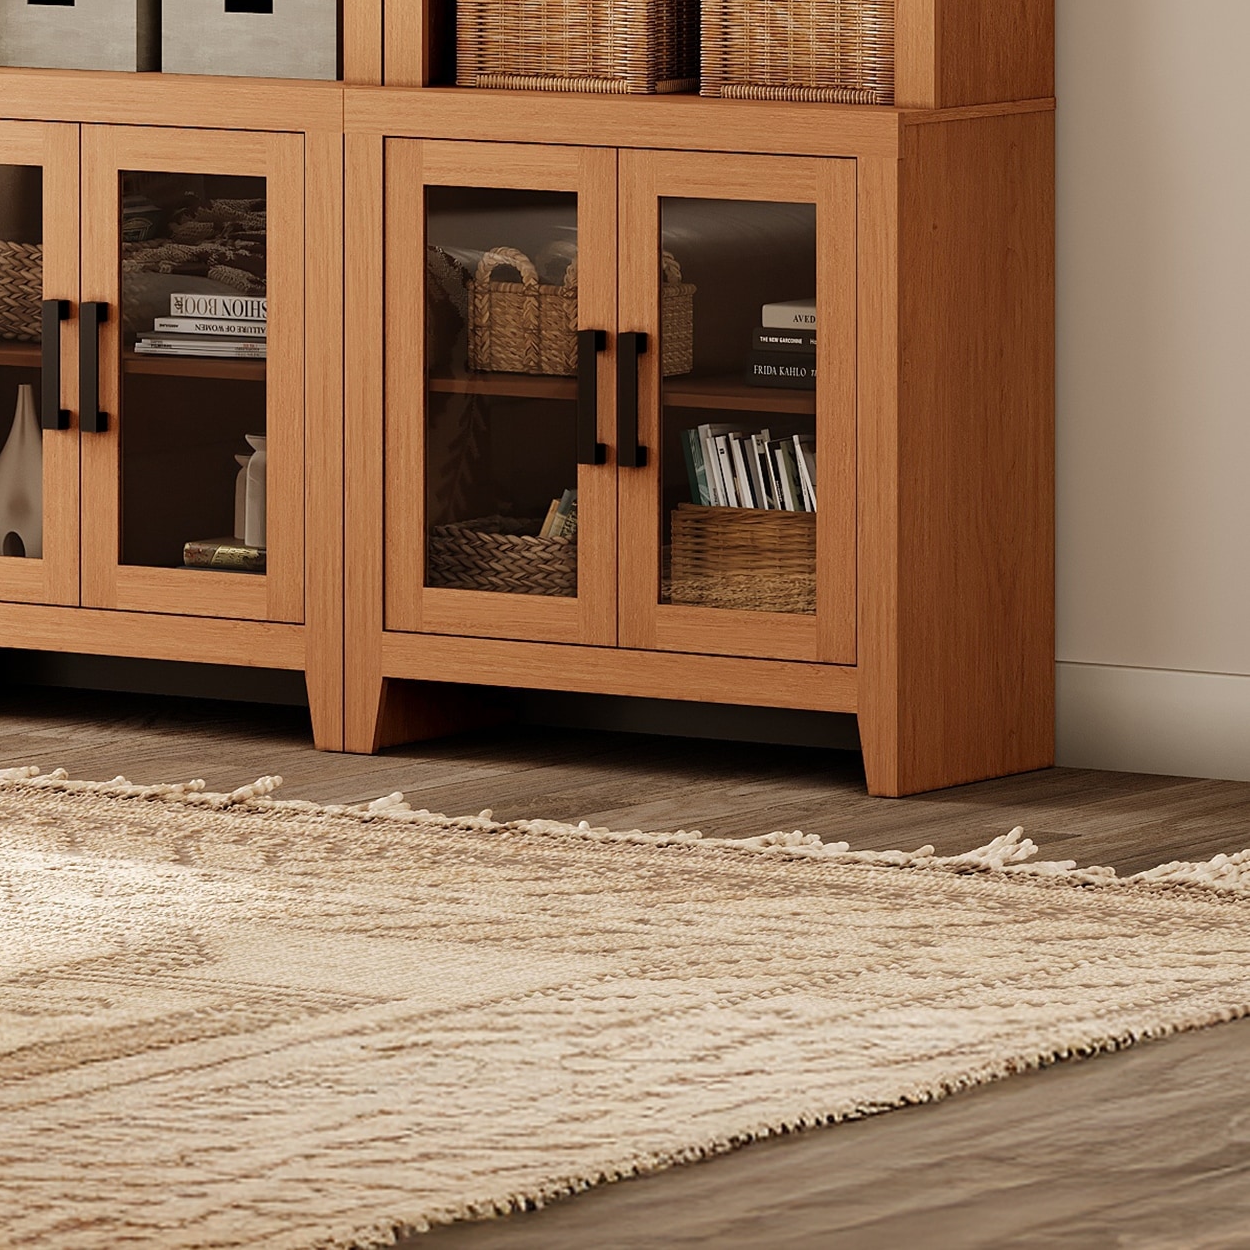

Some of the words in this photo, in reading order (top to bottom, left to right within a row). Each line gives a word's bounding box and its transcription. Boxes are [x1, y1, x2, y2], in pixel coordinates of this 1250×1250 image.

[222, 298, 267, 318] SHION
[793, 314, 816, 323] AVED
[195, 324, 224, 332] WOMEN
[225, 325, 236, 333] OF
[237, 325, 266, 334] ALLURE
[753, 365, 777, 376] FRIDA
[779, 366, 807, 377] KAHLO
